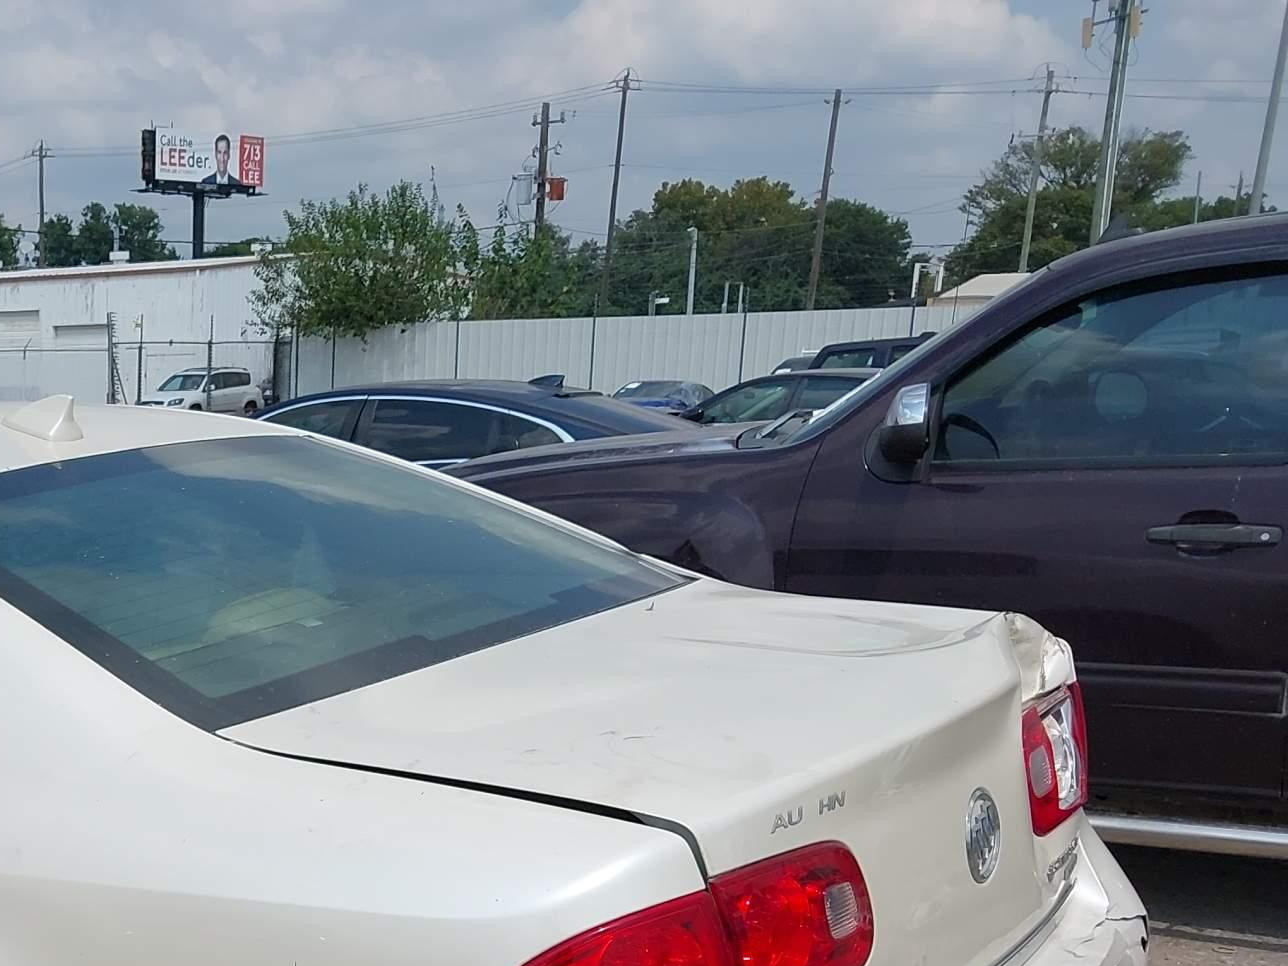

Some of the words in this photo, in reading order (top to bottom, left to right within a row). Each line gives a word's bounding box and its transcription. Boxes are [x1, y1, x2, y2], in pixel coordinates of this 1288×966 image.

[160, 135, 177, 147] Call
[179, 136, 193, 148] the
[160, 147, 212, 169] LEEder.
[243, 144, 261, 161] 713
[243, 160, 261, 170] CALL
[242, 170, 261, 184] LEE
